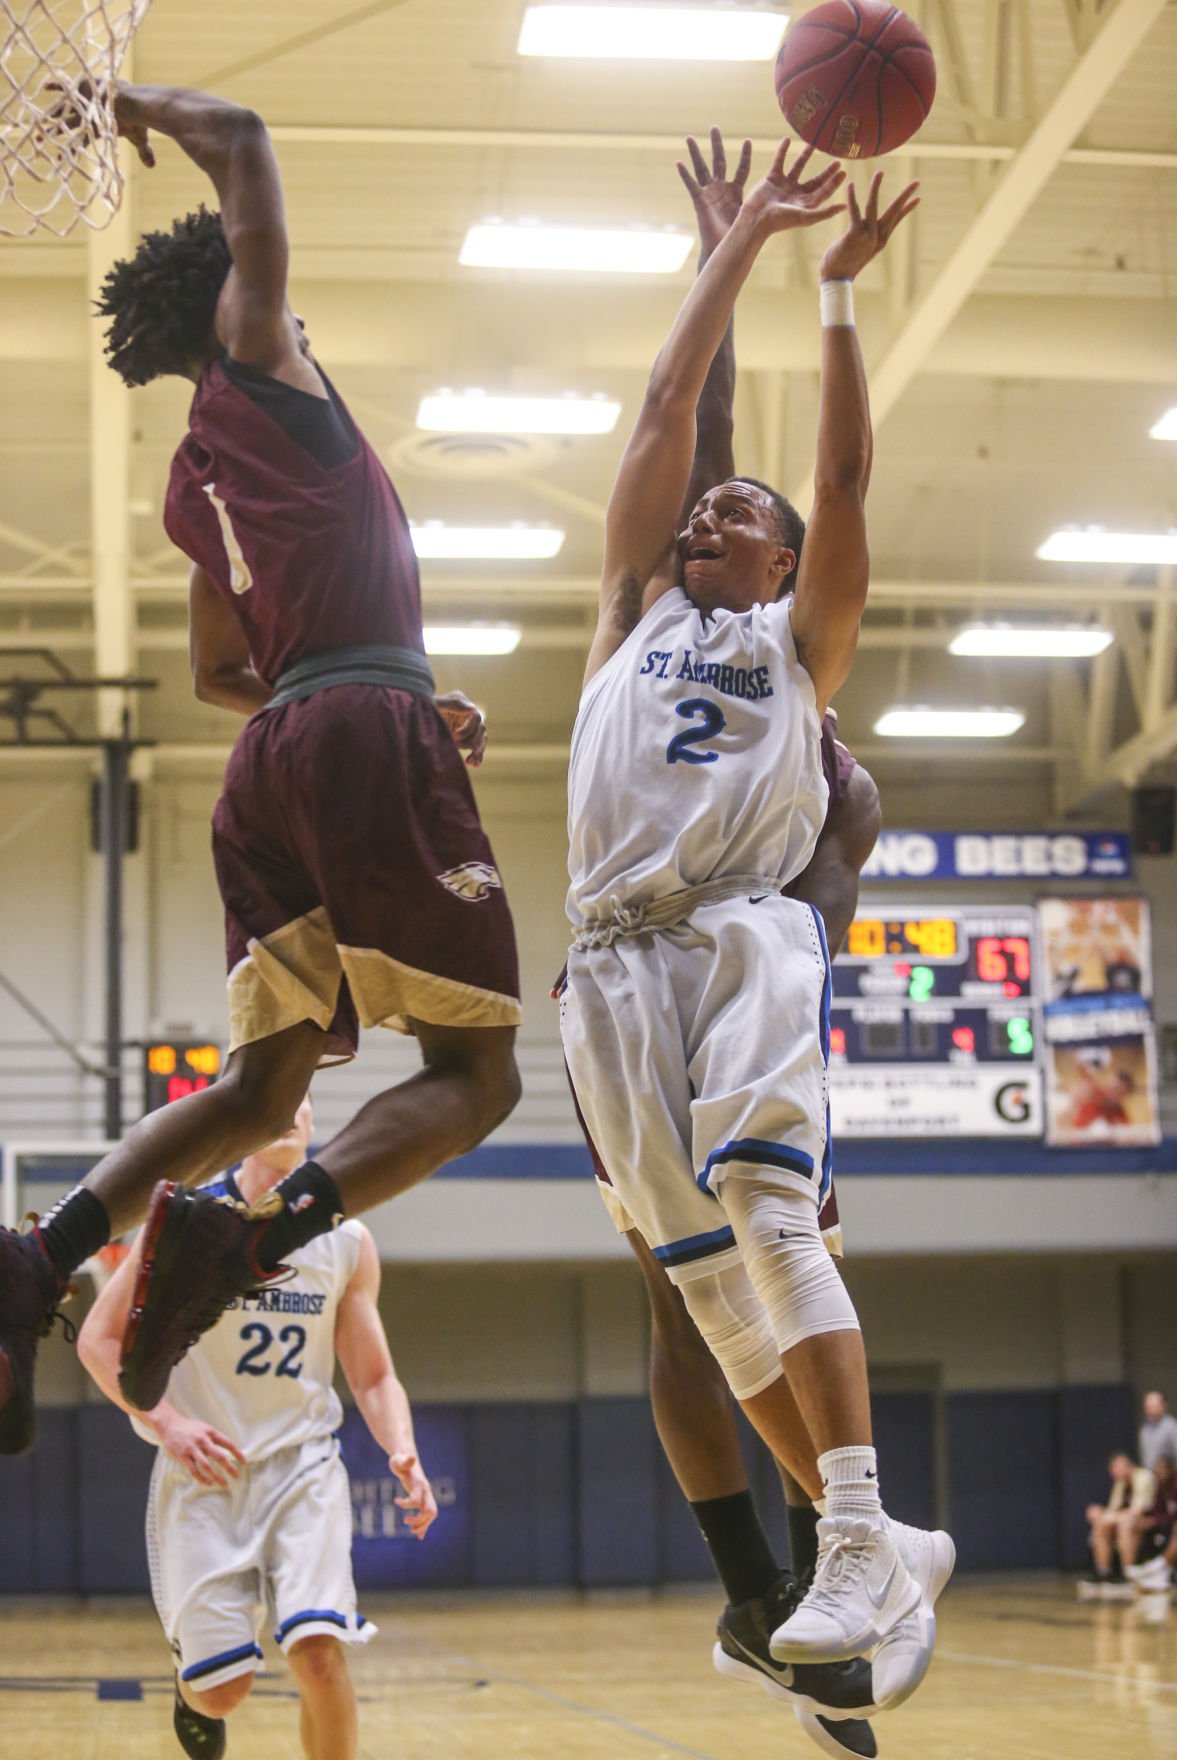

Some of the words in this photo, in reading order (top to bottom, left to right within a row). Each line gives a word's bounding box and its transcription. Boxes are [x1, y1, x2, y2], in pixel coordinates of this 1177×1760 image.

[202, 482, 254, 595] 1
[640, 650, 673, 679] ST.
[676, 650, 774, 700] AMBROSE
[666, 698, 727, 764] 2
[954, 834, 1087, 876] BEES
[977, 937, 1031, 982] 67
[909, 966, 935, 1002] 2
[994, 1082, 1031, 1123] G
[256, 1290, 326, 1315] AMBROSE
[235, 1321, 307, 1380] 22
